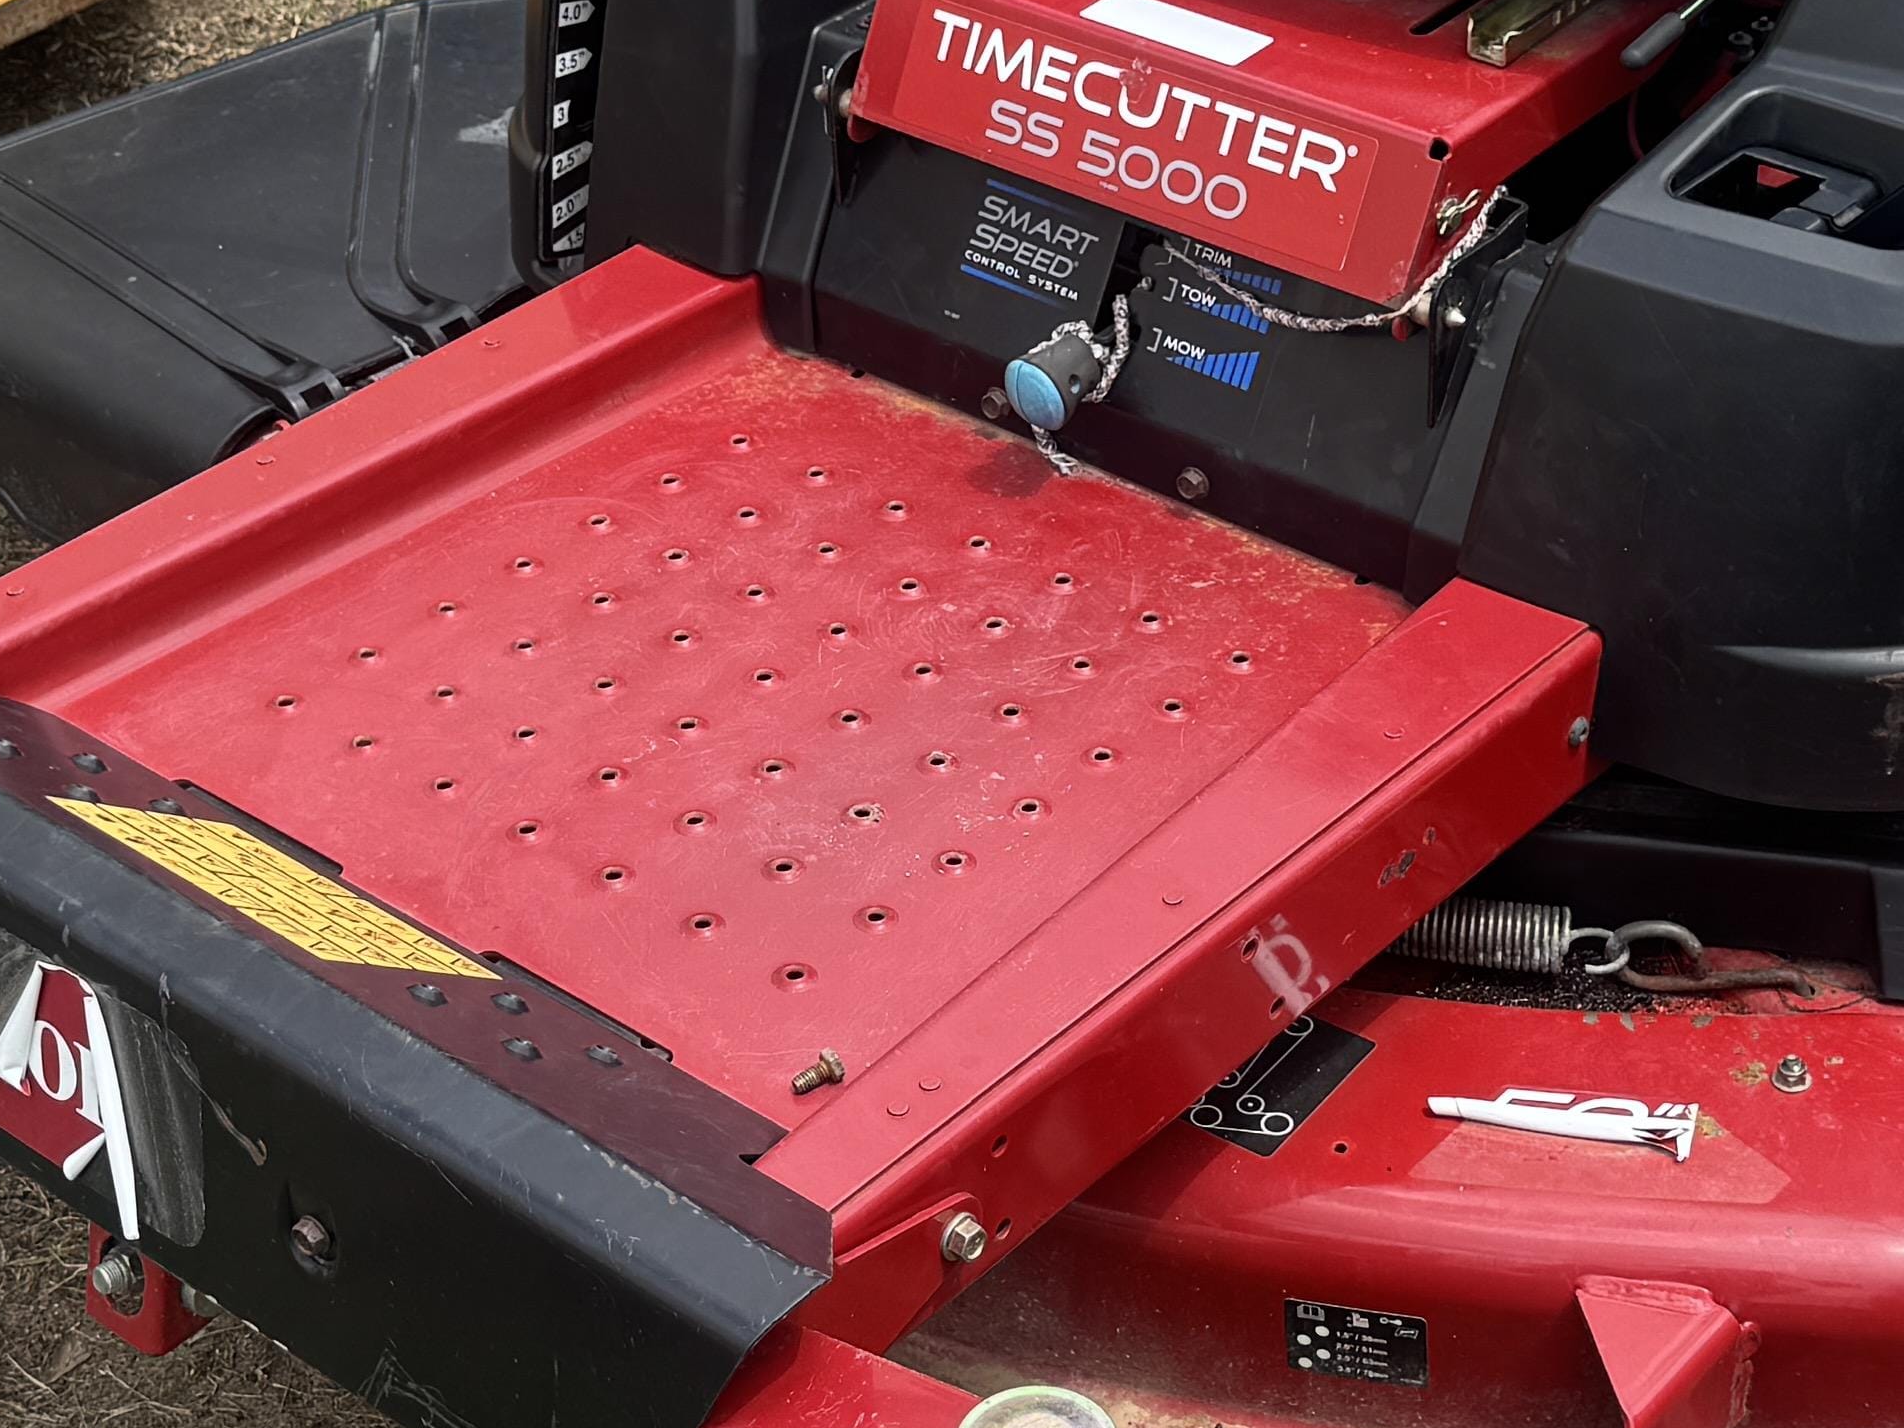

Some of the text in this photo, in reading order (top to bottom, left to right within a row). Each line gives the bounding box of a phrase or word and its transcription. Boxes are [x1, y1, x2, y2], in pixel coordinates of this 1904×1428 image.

[933, 8, 1347, 193] TIMECUTTER
[985, 99, 1248, 220] SS 5000
[969, 223, 1074, 279] SPEED
[978, 195, 1100, 255] SMART
[964, 249, 1079, 301] CONTROL SYSTEM
[1194, 243, 1232, 269] TRIM
[1180, 284, 1217, 308] TOW
[1163, 335, 1206, 360] MOW
